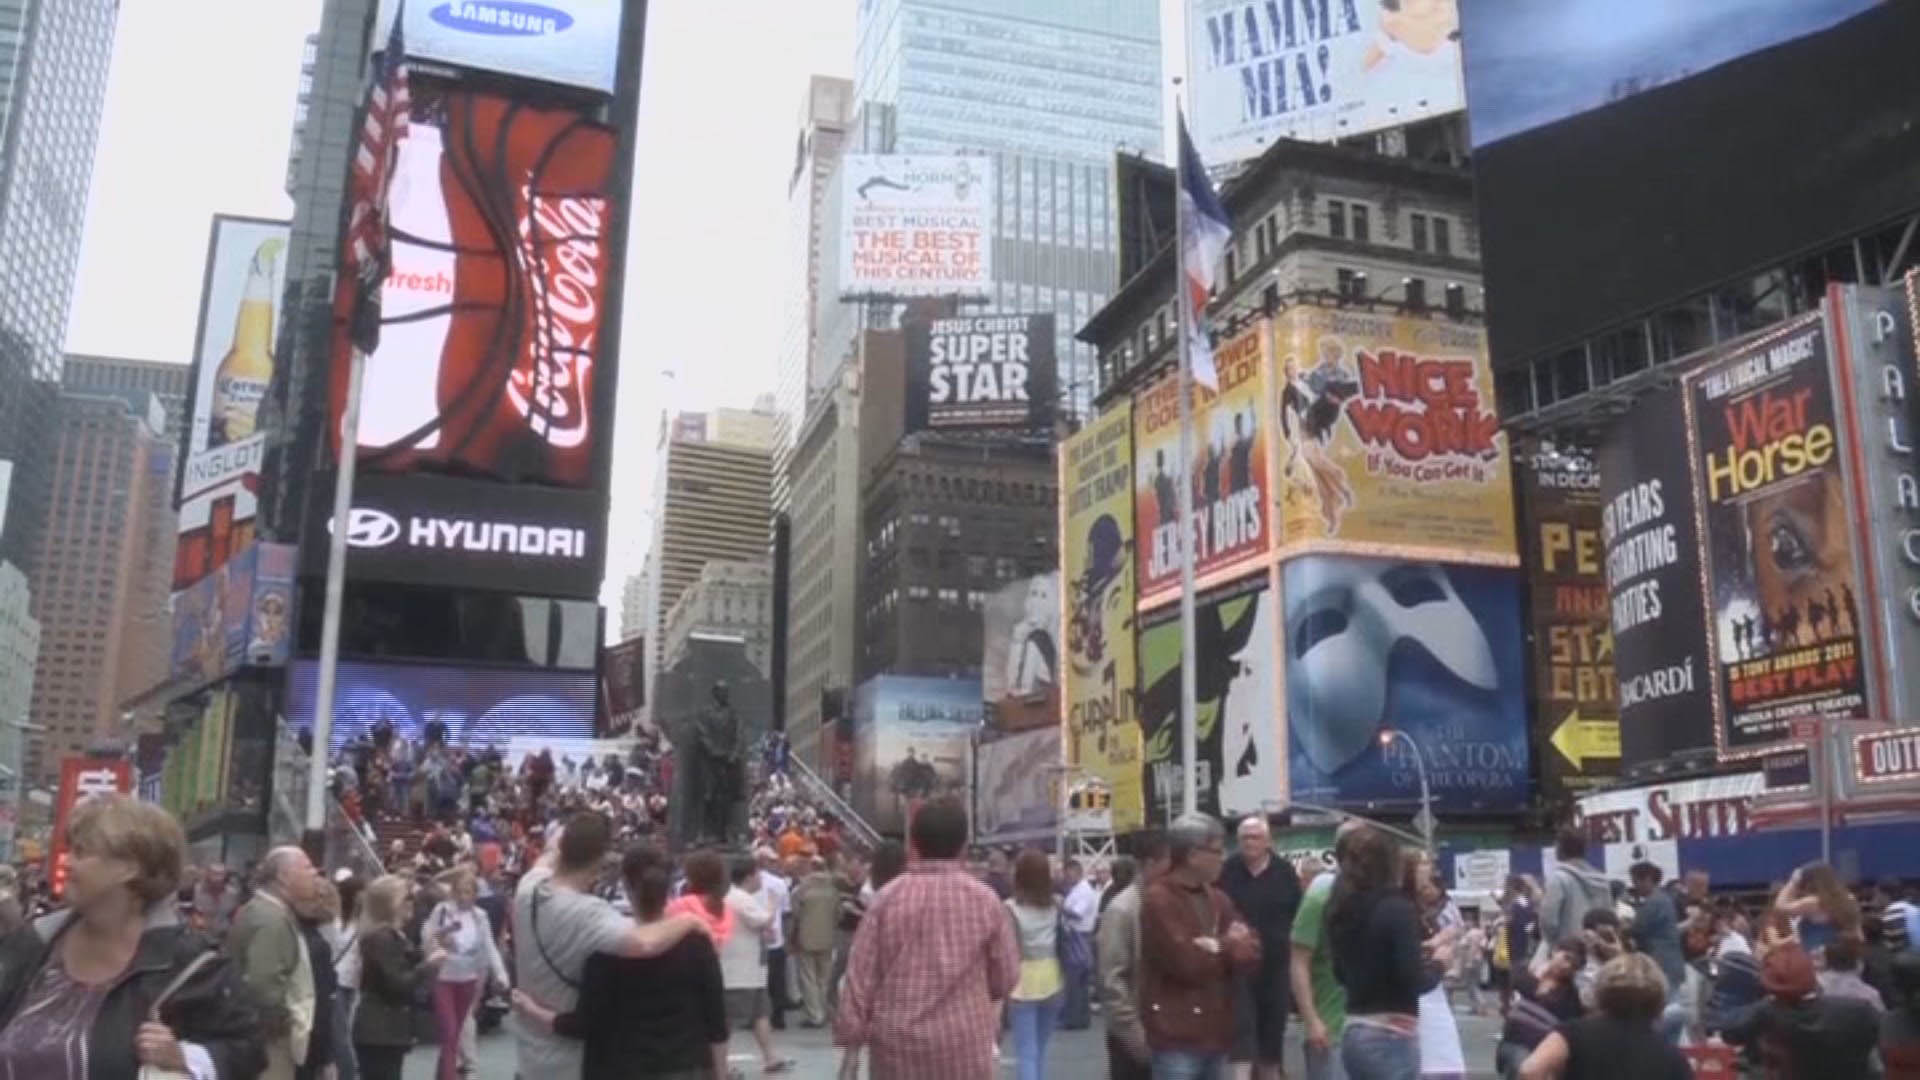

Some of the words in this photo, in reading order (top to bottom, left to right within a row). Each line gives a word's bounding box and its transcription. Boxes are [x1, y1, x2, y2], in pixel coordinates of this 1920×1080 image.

[448, 0, 556, 33] SAMSUNG
[1205, 0, 1361, 68] MAMMA
[1240, 46, 1332, 122] MIA!
[853, 216, 897, 228] BEST
[903, 216, 980, 228] MUSICAL
[855, 230, 905, 250] THE
[913, 231, 981, 250] BEST
[853, 251, 944, 266] MUSICAL
[951, 252, 980, 266] OF
[855, 266, 892, 281] THIS
[930, 319, 972, 335] JESUS
[975, 316, 1028, 332] CHRIST
[929, 333, 1029, 364] SUPER
[929, 362, 1030, 402] STAR
[1357, 351, 1478, 407] NICE
[1347, 400, 1501, 461] WORK
[1725, 387, 1813, 450] War
[1706, 424, 1833, 502] Horse
[1213, 485, 1262, 554] BOYS
[1615, 478, 1665, 532] YEARS
[409, 517, 585, 557] HYUNDAI
[1732, 672, 1787, 704] BEST
[1792, 657, 1857, 692] PLAY
